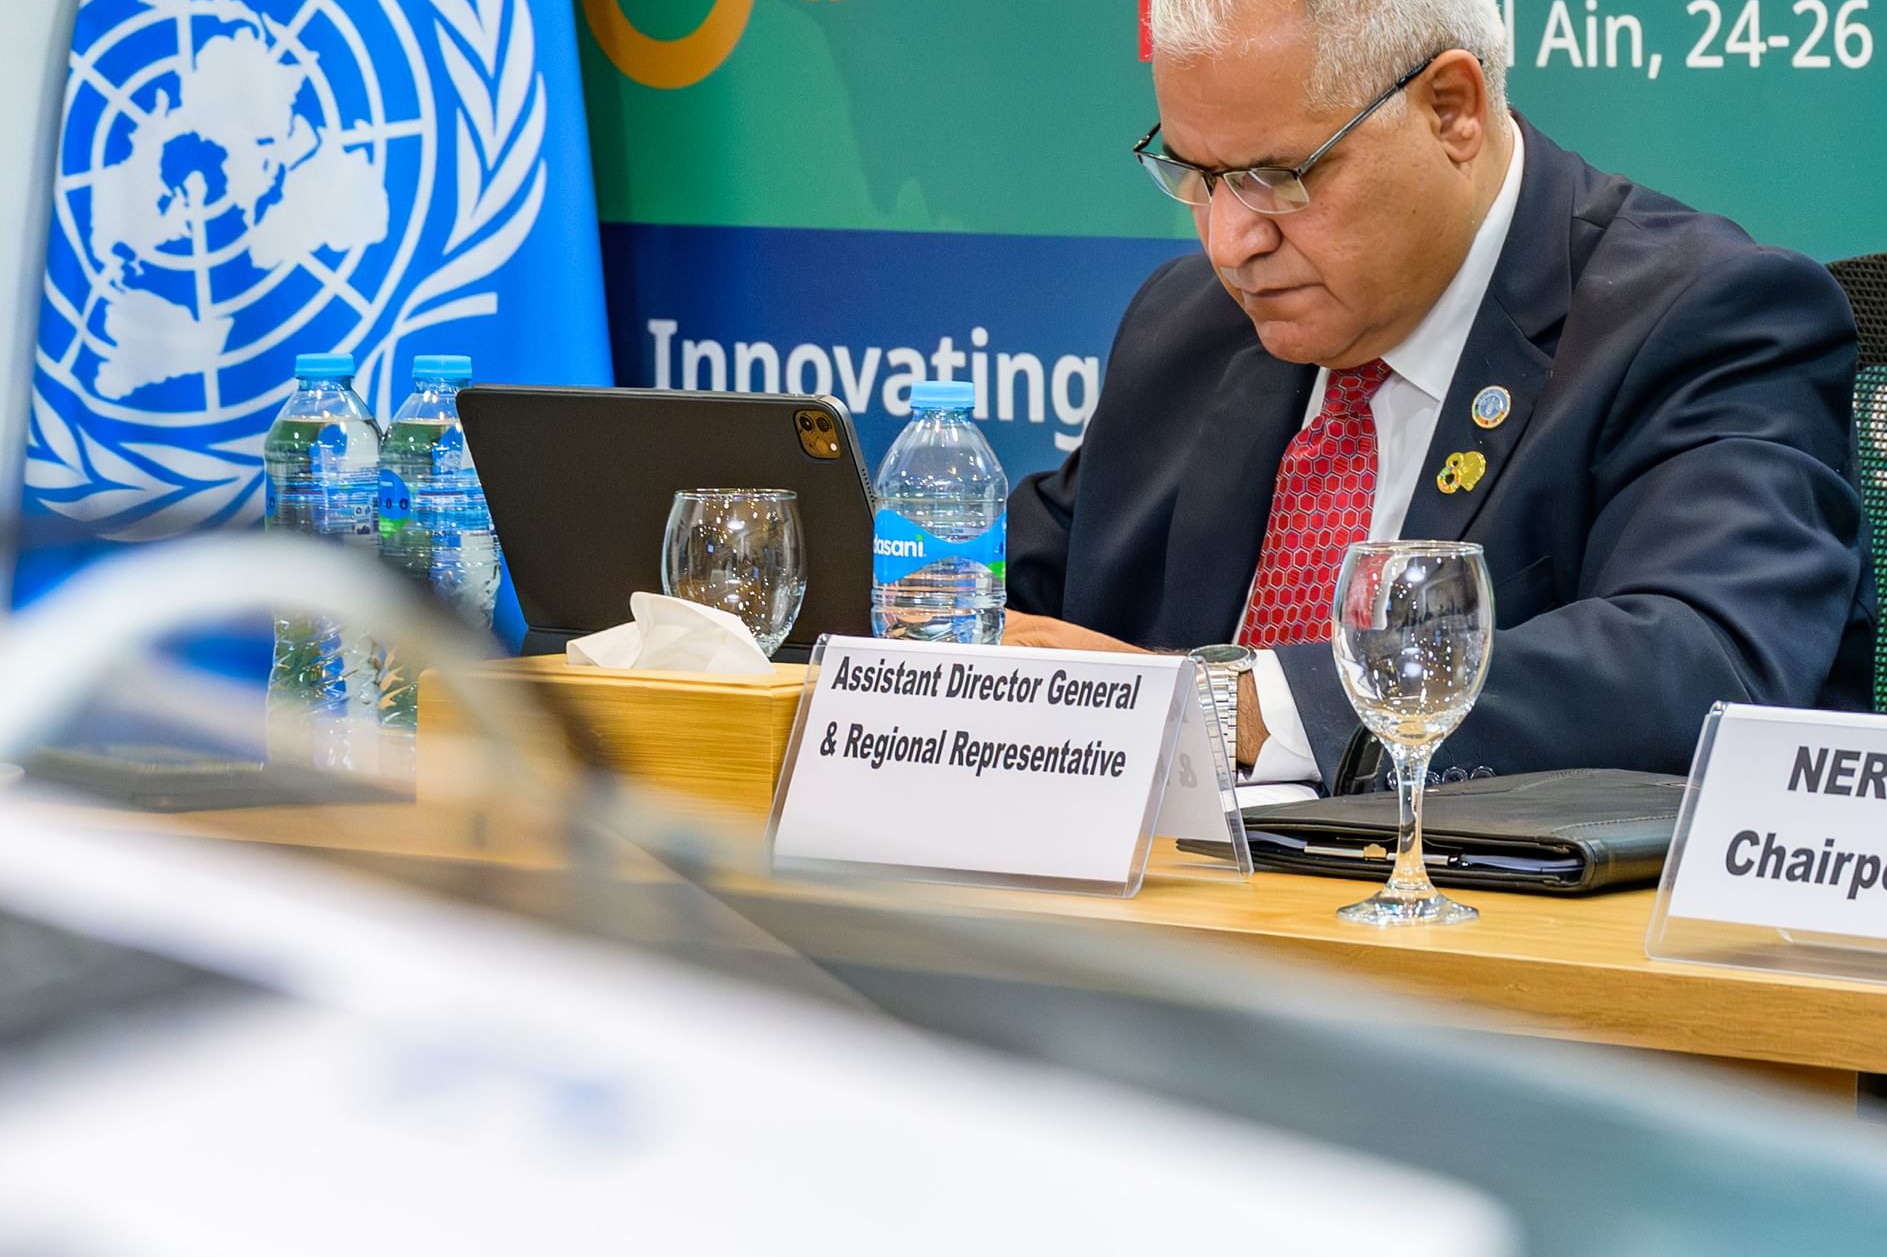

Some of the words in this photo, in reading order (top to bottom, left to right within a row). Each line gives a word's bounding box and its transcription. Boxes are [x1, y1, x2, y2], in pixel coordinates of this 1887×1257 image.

[647, 318, 1099, 452] Innovating
[831, 655, 942, 698] Assistant
[945, 663, 1043, 704] Director
[1047, 669, 1142, 710] General
[819, 722, 838, 757] &
[843, 723, 947, 770] Regional
[949, 731, 1127, 777] Representative
